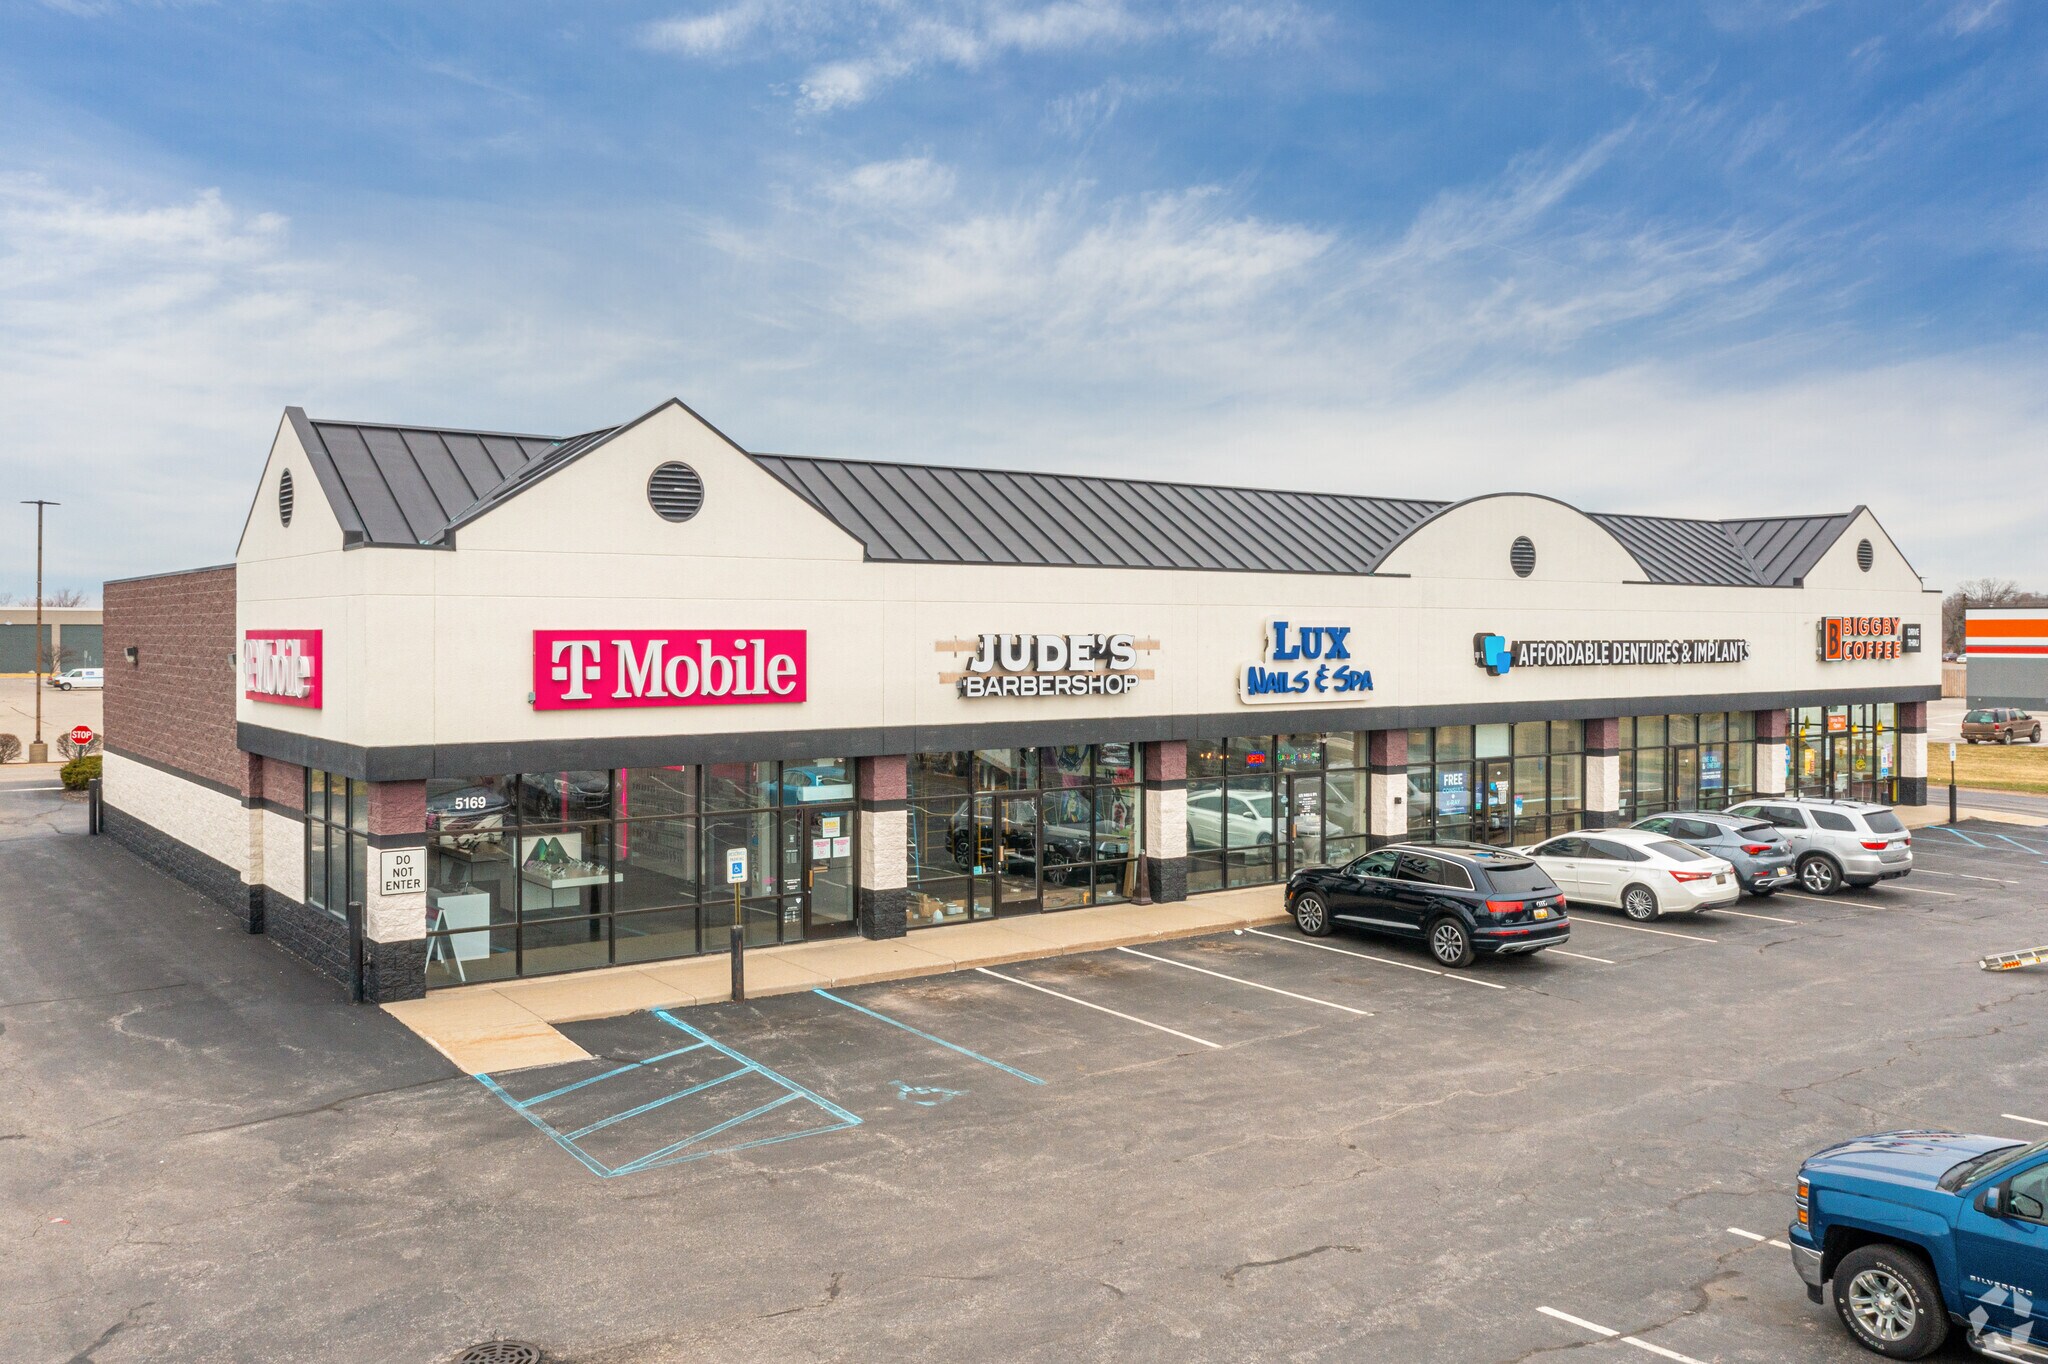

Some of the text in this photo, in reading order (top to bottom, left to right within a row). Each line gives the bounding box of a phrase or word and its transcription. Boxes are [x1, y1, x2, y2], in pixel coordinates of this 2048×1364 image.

[1843, 617, 1900, 636] BIGGBY
[1907, 628, 1919, 636] DRIVE
[1907, 638, 1919, 646] THRU
[969, 634, 1137, 673] JUDE'S
[1519, 641, 1751, 665] AFFORDABLE DENTURES & IMPLANTS
[1843, 641, 1900, 660] COFFEE
[551, 639, 797, 700] T Mobile
[966, 674, 1140, 697] BARBERSHOP
[1314, 664, 1330, 693] &
[1247, 753, 1265, 764] OPEN
[1443, 773, 1463, 786] FREE
[455, 796, 486, 809] 5169
[396, 855, 411, 865] DO
[392, 867, 414, 878] NOT
[386, 879, 421, 891] ENTER
[1970, 1275, 2033, 1297] SILVERADO
